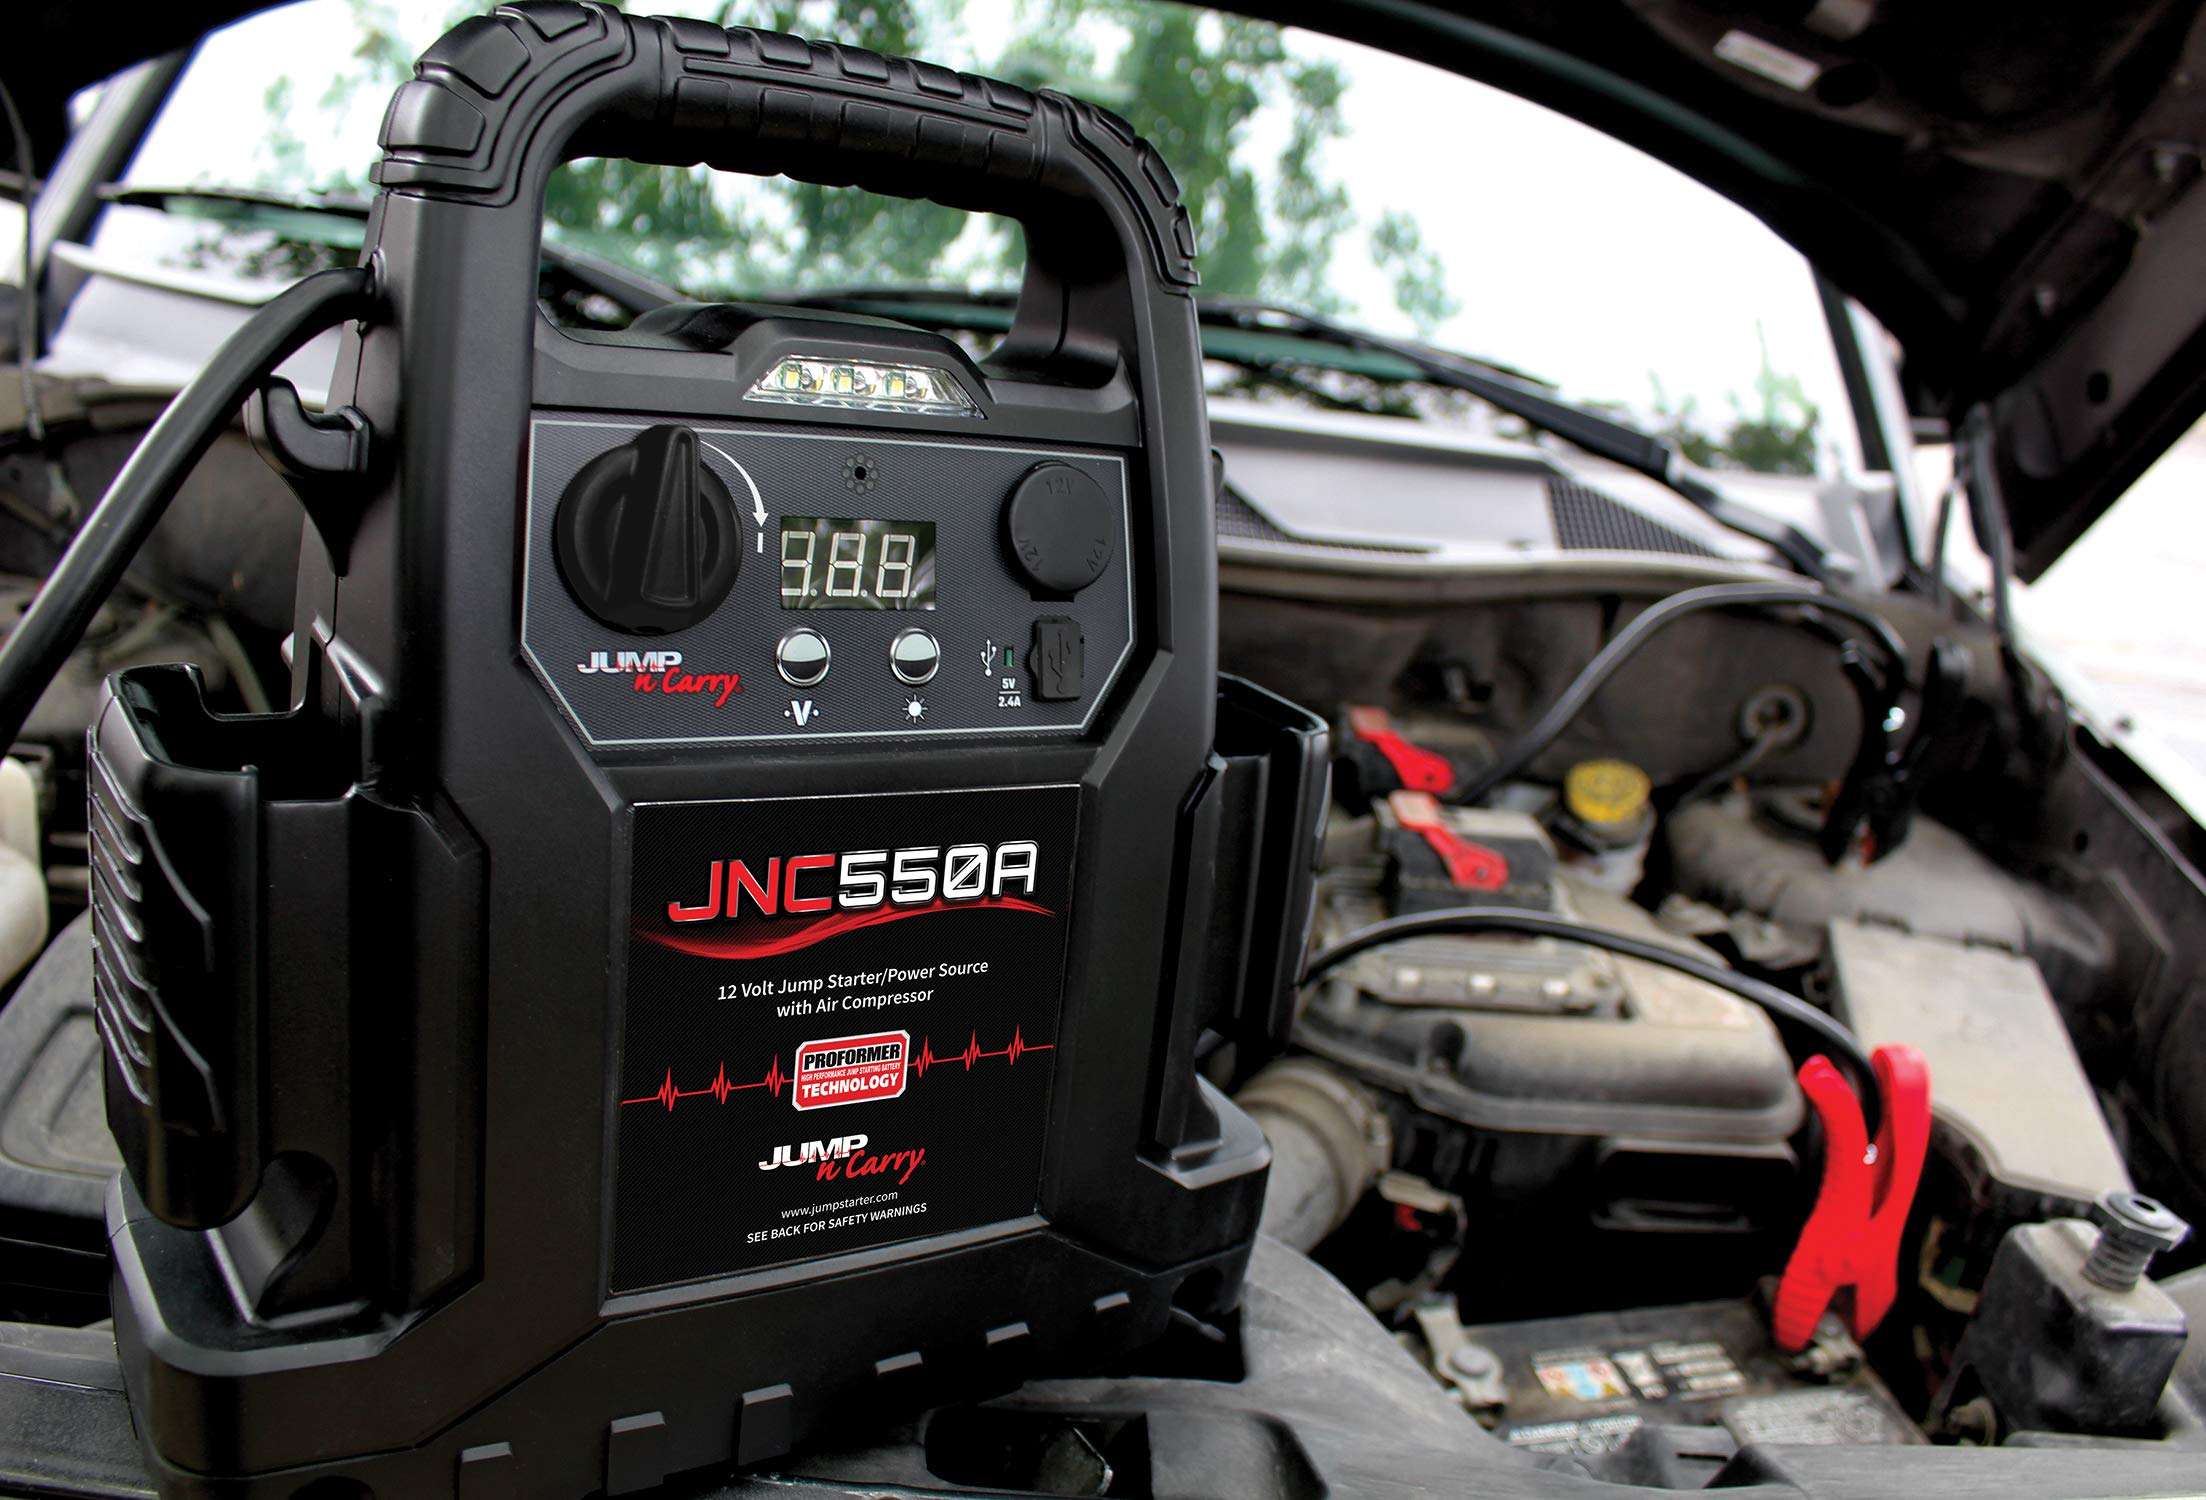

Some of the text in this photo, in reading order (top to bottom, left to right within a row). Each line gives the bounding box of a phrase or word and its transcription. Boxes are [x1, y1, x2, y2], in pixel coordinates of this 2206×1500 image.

[577, 651, 682, 674] JUMP
[662, 667, 741, 708] Carry
[1002, 678, 1016, 689] 5V
[998, 696, 1021, 707] 2.4A
[668, 839, 1039, 922] JNC550A
[718, 961, 989, 1001] 12 Volt Jump Starter/Power Source
[776, 987, 935, 1018] with Air Compressor
[803, 1043, 901, 1070] PROFORMER
[801, 1062, 901, 1082] HIGH PERFORMANCE JUMP STARTING BATTERY
[801, 1072, 900, 1099] TECHNOLOGY
[758, 1134, 869, 1171] JUMP
[845, 1148, 925, 1185] Carry
[781, 1191, 898, 1219] www.jumpstarter.com
[746, 1202, 928, 1244] SEE BACK FOR SAFETY WARNINGS
